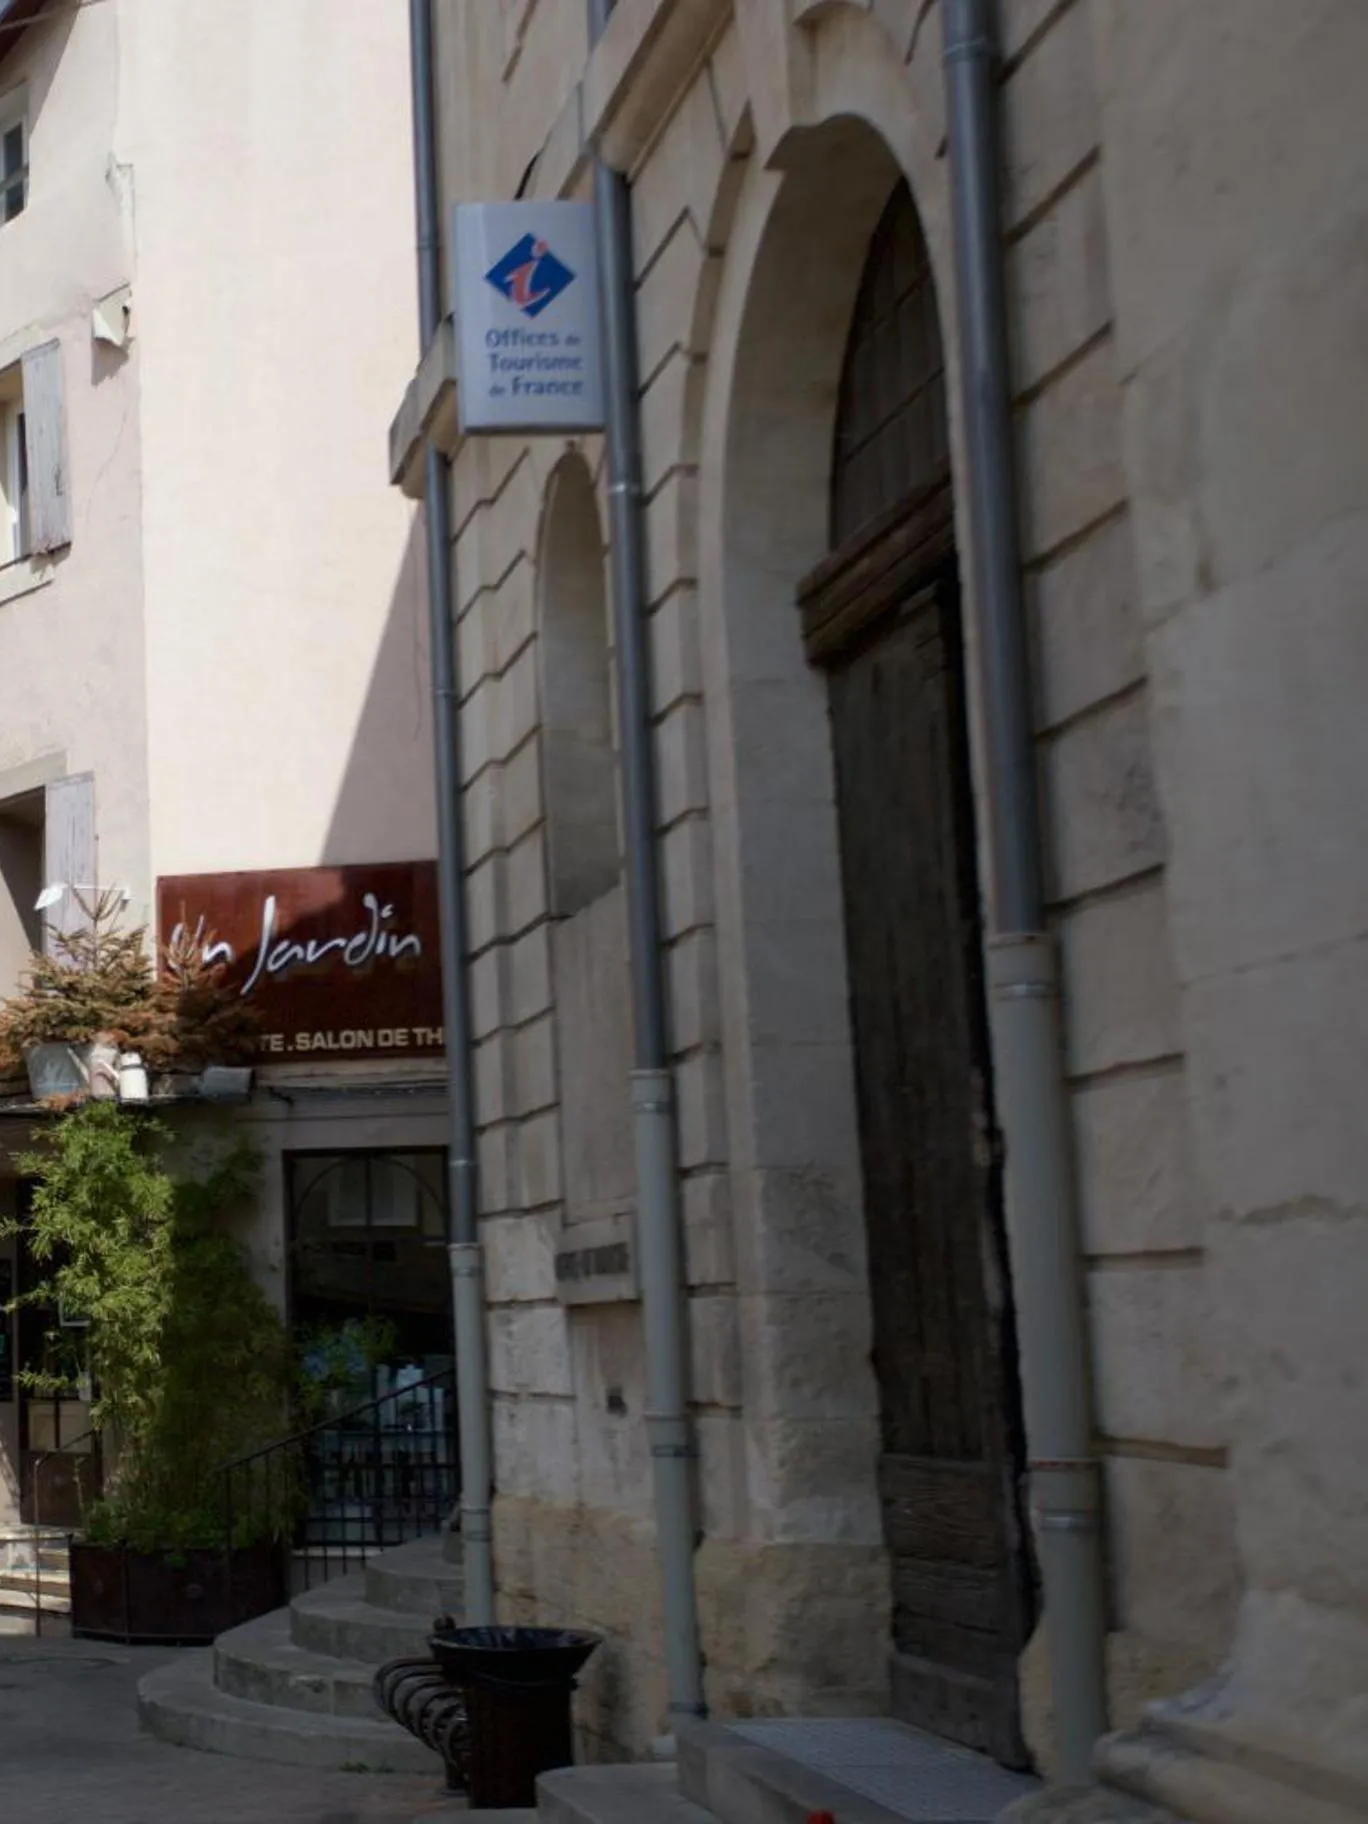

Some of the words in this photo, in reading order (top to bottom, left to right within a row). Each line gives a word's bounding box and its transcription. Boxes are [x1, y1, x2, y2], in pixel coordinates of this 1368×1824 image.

[485, 328, 559, 348] Offices
[489, 352, 583, 371] Tourisme
[513, 376, 584, 396] France
[240, 892, 421, 995] Jardin
[377, 1028, 410, 1047] DE
